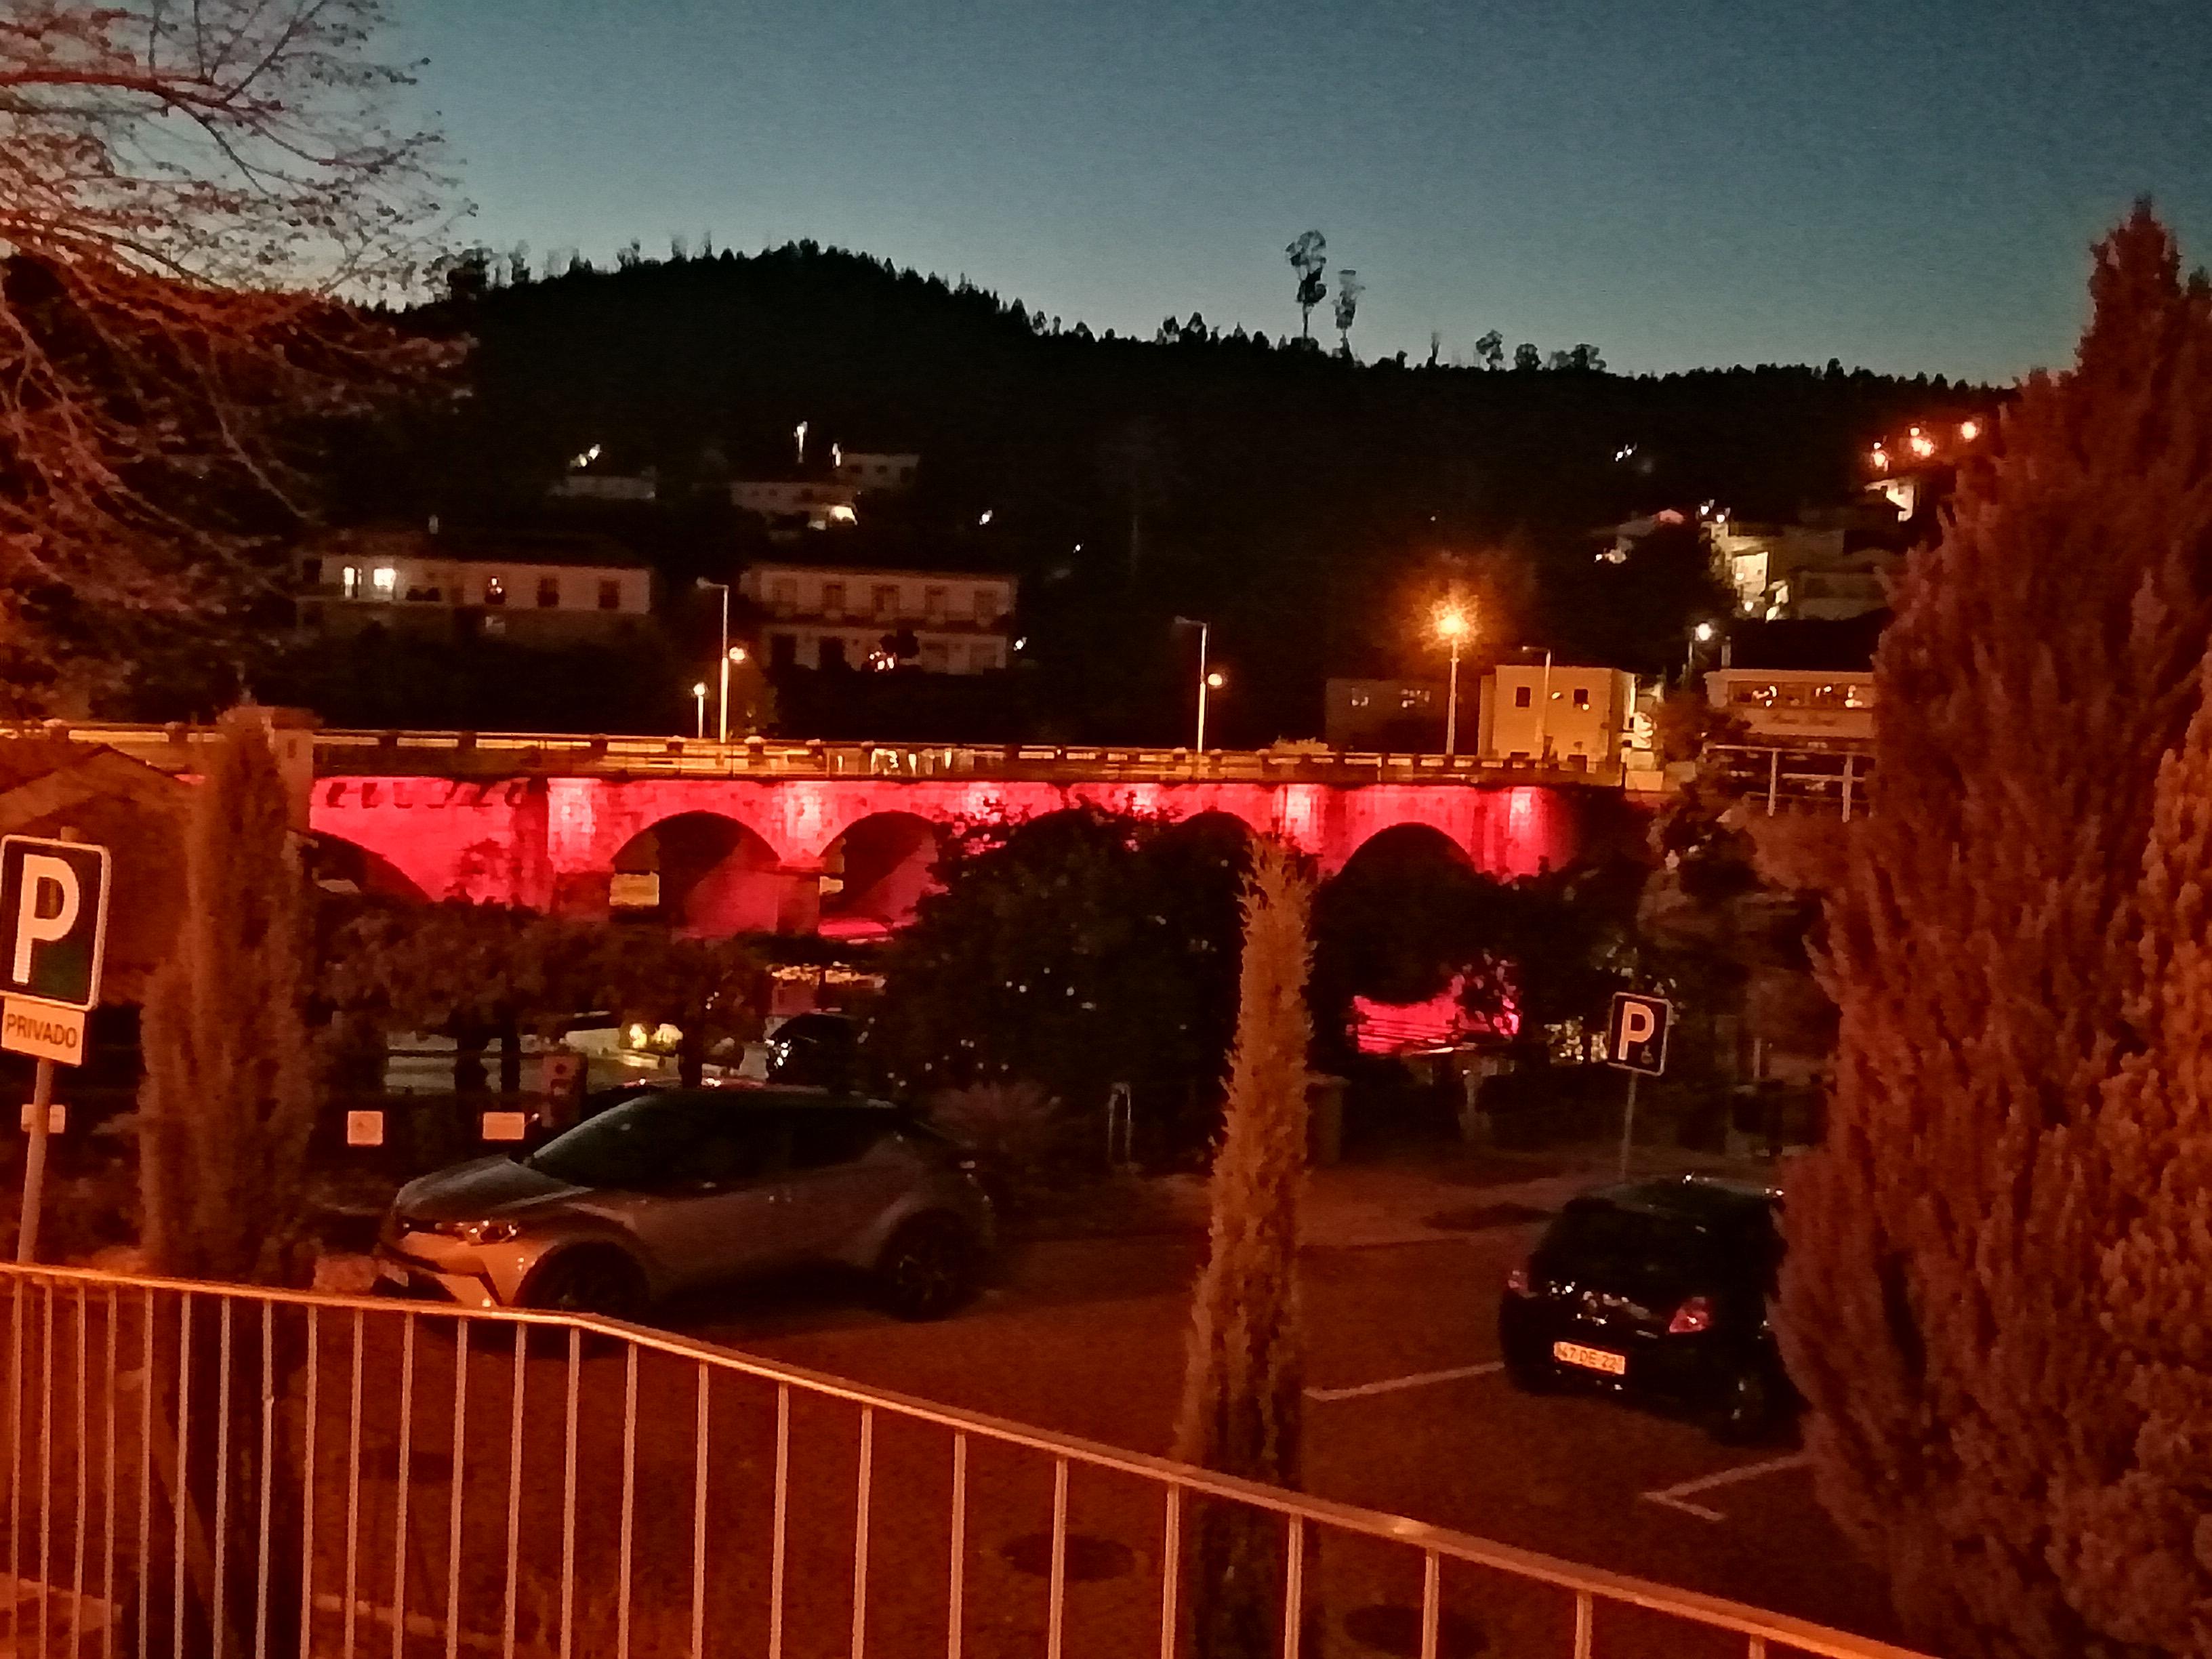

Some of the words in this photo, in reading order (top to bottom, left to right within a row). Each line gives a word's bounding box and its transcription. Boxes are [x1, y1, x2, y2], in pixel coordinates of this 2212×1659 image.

[13, 853, 79, 984] P
[5, 1013, 77, 1049] PRIVADO
[1618, 1001, 1655, 1061] P
